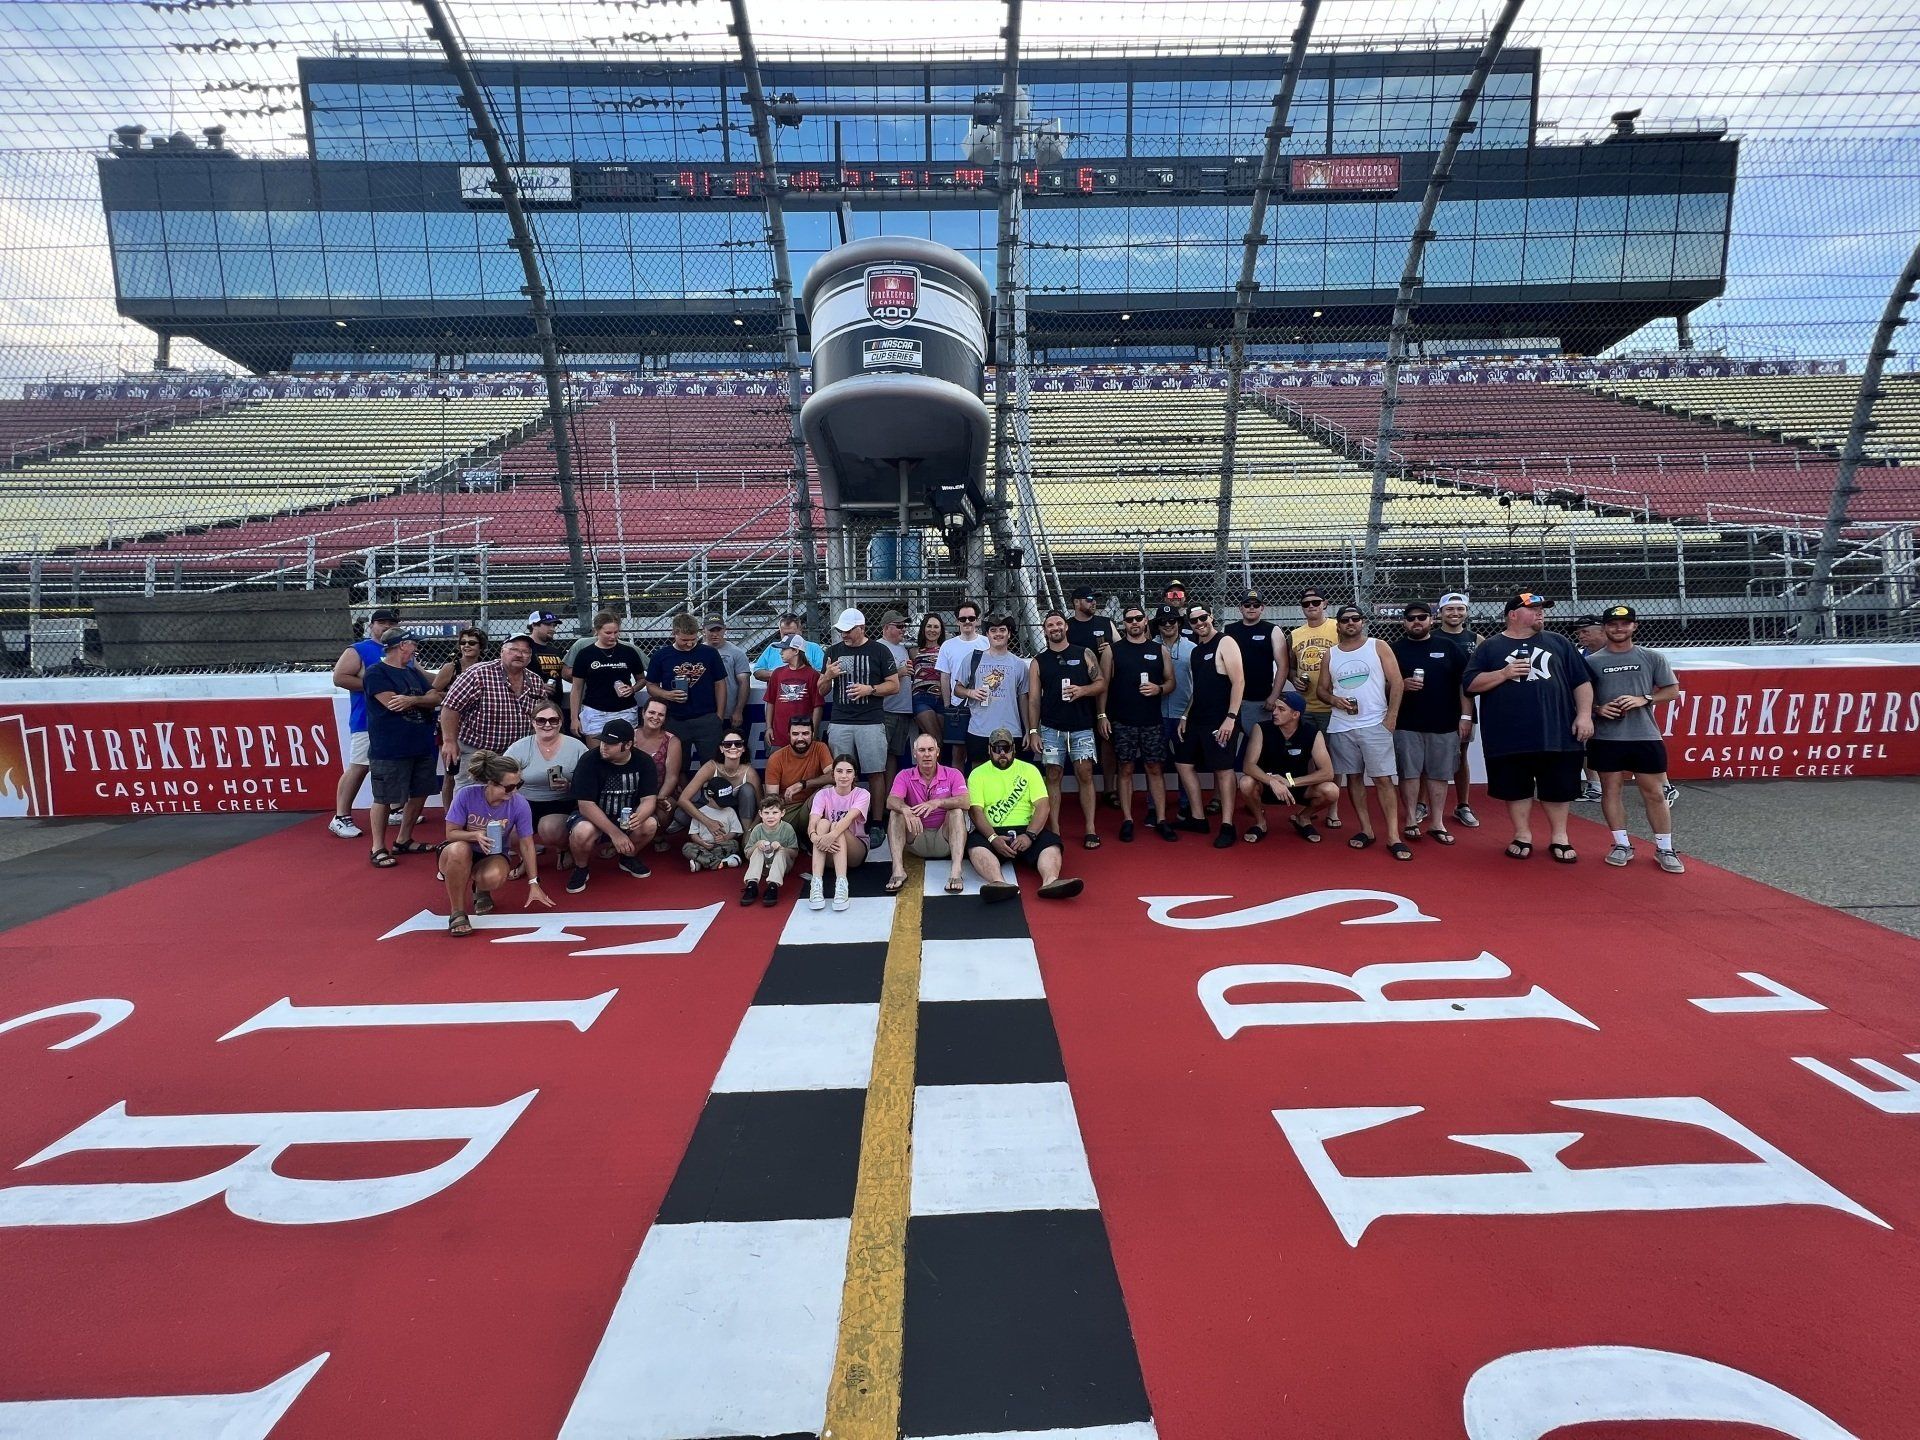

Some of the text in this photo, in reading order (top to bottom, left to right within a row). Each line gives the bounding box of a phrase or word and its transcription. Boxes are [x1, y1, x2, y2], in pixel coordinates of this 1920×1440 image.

[1335, 164, 1393, 177] FIREKEEPERS
[1054, 176, 1061, 186] 8
[1109, 175, 1116, 184] 9
[1161, 173, 1173, 183] 10
[871, 290, 914, 300] FIREKEEPERS
[873, 307, 911, 318] 400
[881, 340, 914, 350] NASCAR
[871, 352, 914, 361] CUP SERIES
[1579, 369, 1599, 380] ally
[1639, 368, 1659, 379] ally
[1699, 366, 1719, 378] ally
[1759, 364, 1780, 375] ally
[1819, 364, 1840, 374] ally
[1282, 375, 1302, 387] ally
[1341, 374, 1361, 386] ally
[1399, 373, 1420, 385] ally
[1458, 372, 1478, 384] ally
[1517, 370, 1537, 382] ally
[1044, 380, 1064, 392] ally
[1103, 379, 1123, 391] ally
[1162, 378, 1182, 389] ally
[64, 388, 85, 399] ally
[127, 388, 149, 399] ally
[189, 387, 210, 398] ally
[253, 388, 274, 399] ally
[314, 387, 336, 398] ally
[380, 387, 401, 398] ally
[502, 386, 523, 398] ally
[562, 385, 583, 397] ally
[623, 384, 643, 396] ally
[686, 384, 707, 396] ally
[746, 384, 767, 396] ally
[452, 625, 457, 635] 1
[1603, 665, 1640, 673] CBOYSTV
[1662, 688, 1920, 737] FIREKEEPERS
[55, 722, 330, 772] FIREKEEPERS
[1684, 744, 1888, 762] CASINO HOTEL
[1712, 764, 1855, 778] BATTLE CREEK
[95, 778, 308, 798] CASINO HOTEL
[131, 798, 279, 813] BATTLE CREEK
[993, 778, 1027, 824] CAMPING
